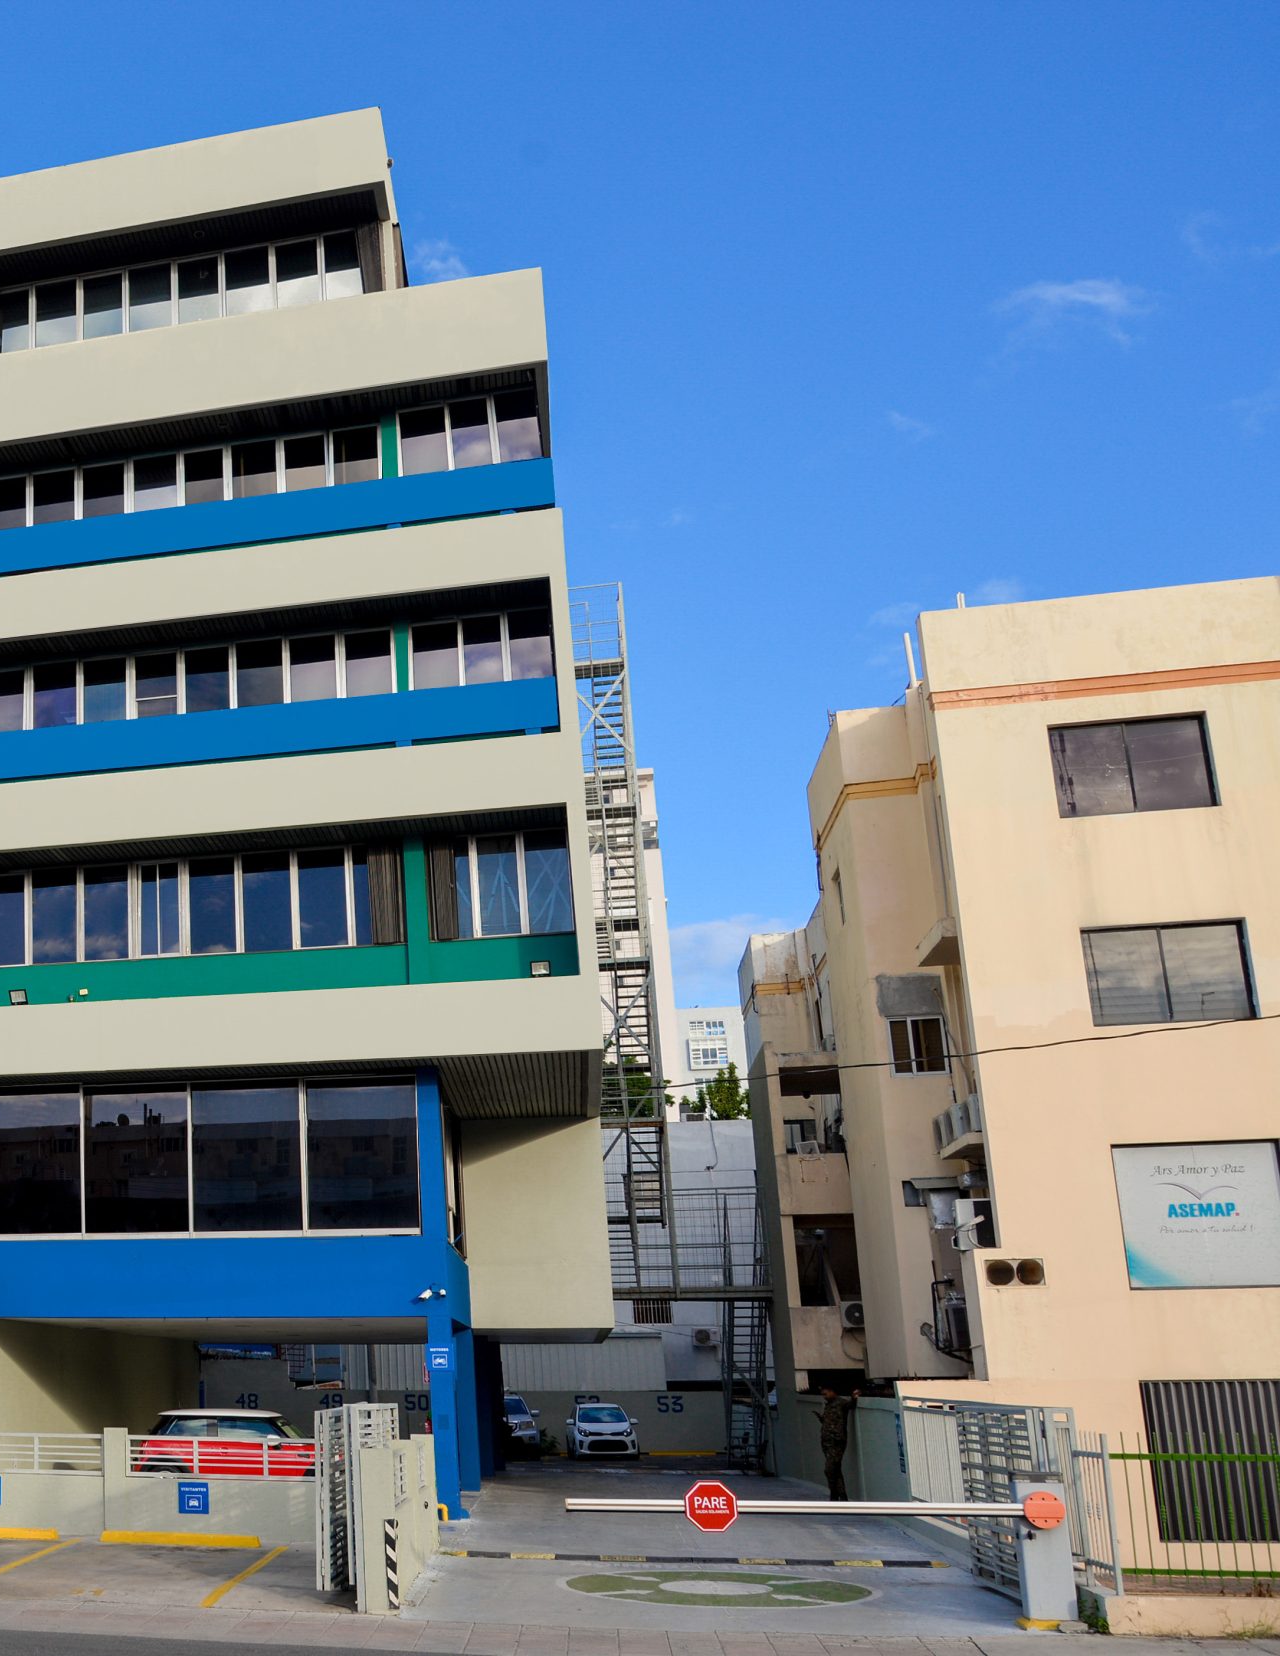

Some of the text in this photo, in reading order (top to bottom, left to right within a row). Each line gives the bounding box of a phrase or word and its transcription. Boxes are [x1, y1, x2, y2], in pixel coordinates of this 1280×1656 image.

[1150, 1163, 1245, 1178] Ars Amor y Paz
[235, 1393, 259, 1409] 48
[320, 1394, 343, 1409] 49
[404, 1394, 430, 1411] 50
[657, 1395, 684, 1413] 53
[693, 1496, 728, 1509] PARE
